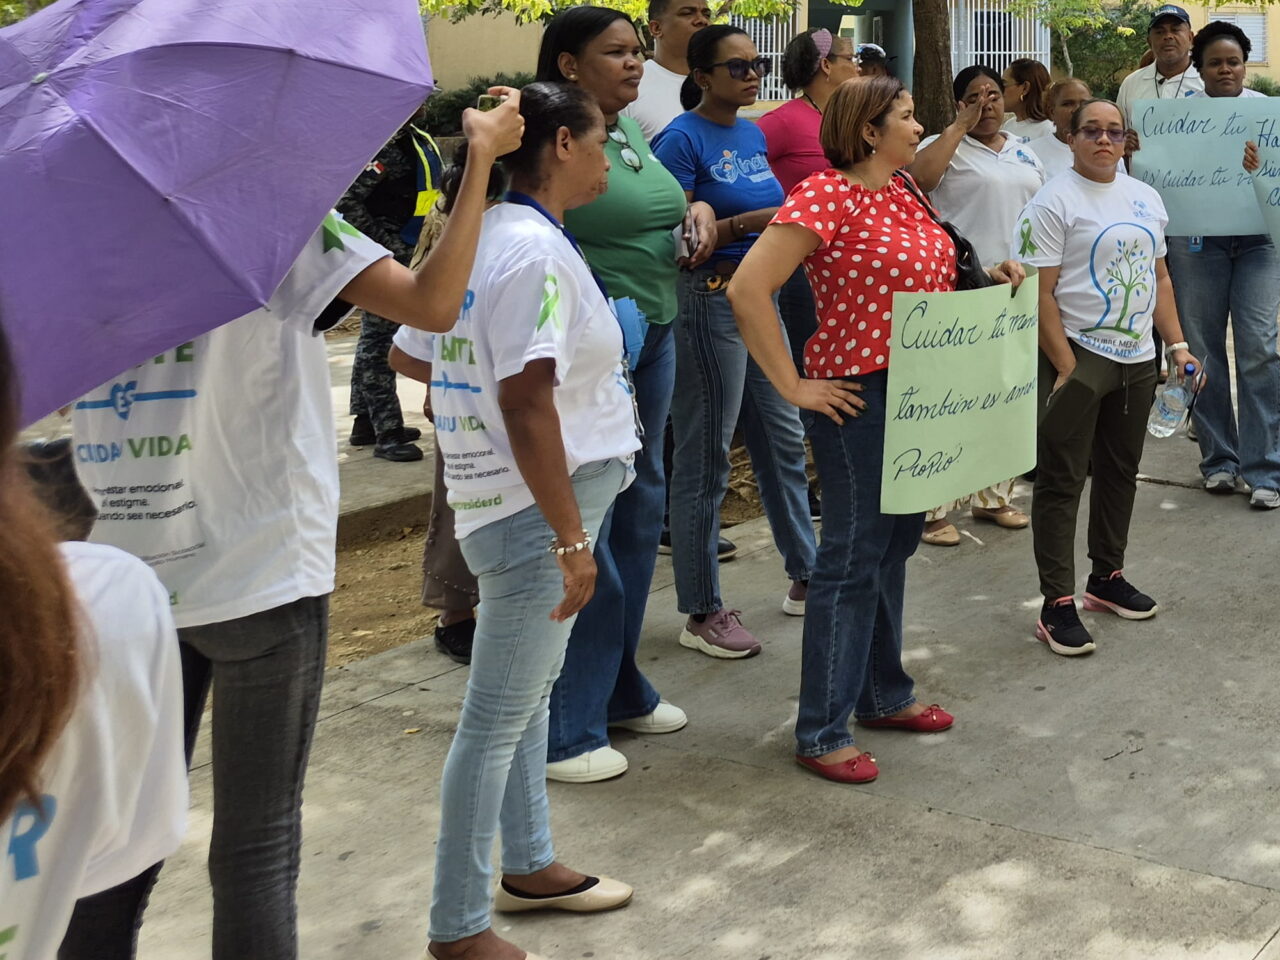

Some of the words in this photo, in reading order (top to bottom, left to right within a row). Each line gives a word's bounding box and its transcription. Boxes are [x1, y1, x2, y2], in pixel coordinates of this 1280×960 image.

[1142, 106, 1216, 138] Cuidar
[1220, 112, 1247, 137] tu
[901, 300, 983, 350] Cuidar
[988, 307, 1007, 340] tu
[980, 391, 1001, 410] es
[127, 434, 192, 458] VIDA
